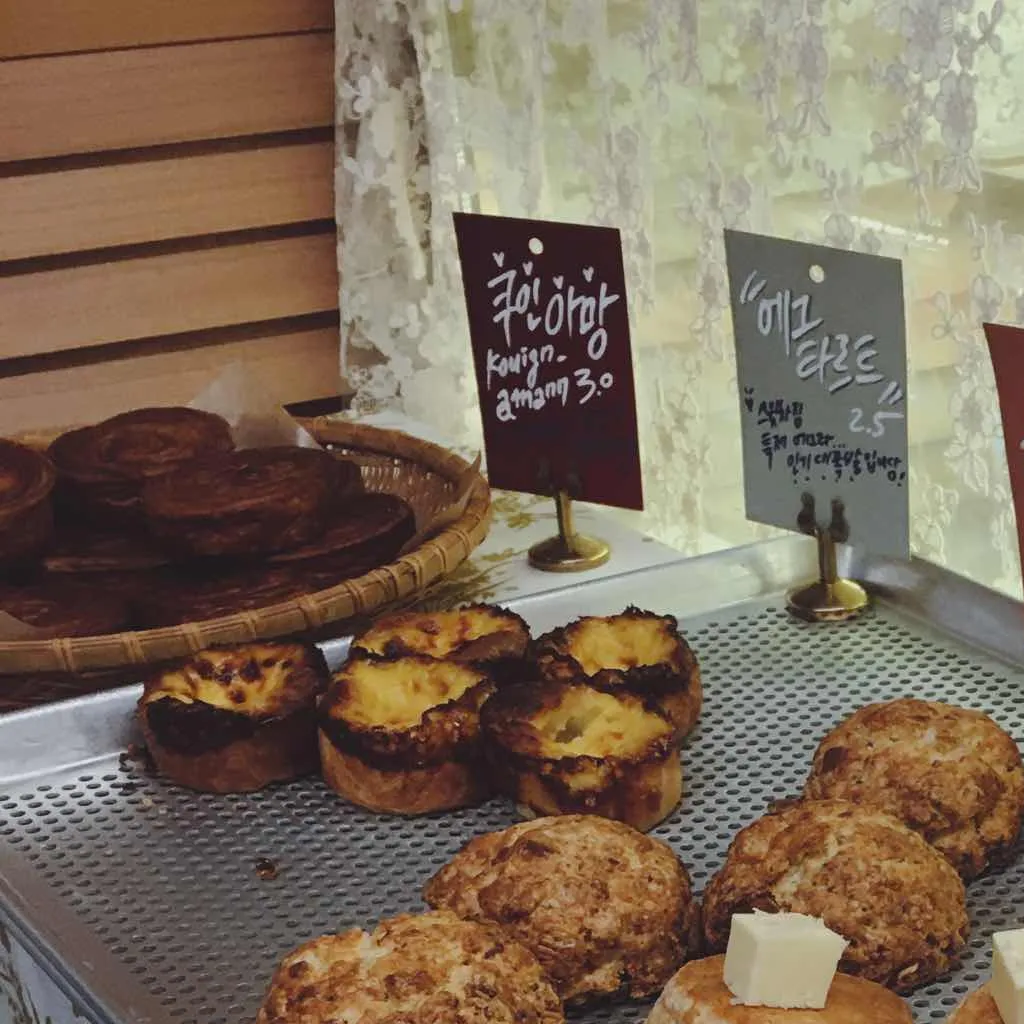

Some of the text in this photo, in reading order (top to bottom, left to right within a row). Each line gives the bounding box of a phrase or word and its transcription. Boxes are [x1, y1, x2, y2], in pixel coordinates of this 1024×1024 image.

[496, 367, 614, 421] amann 3.0
[849, 407, 904, 438] 2.5
